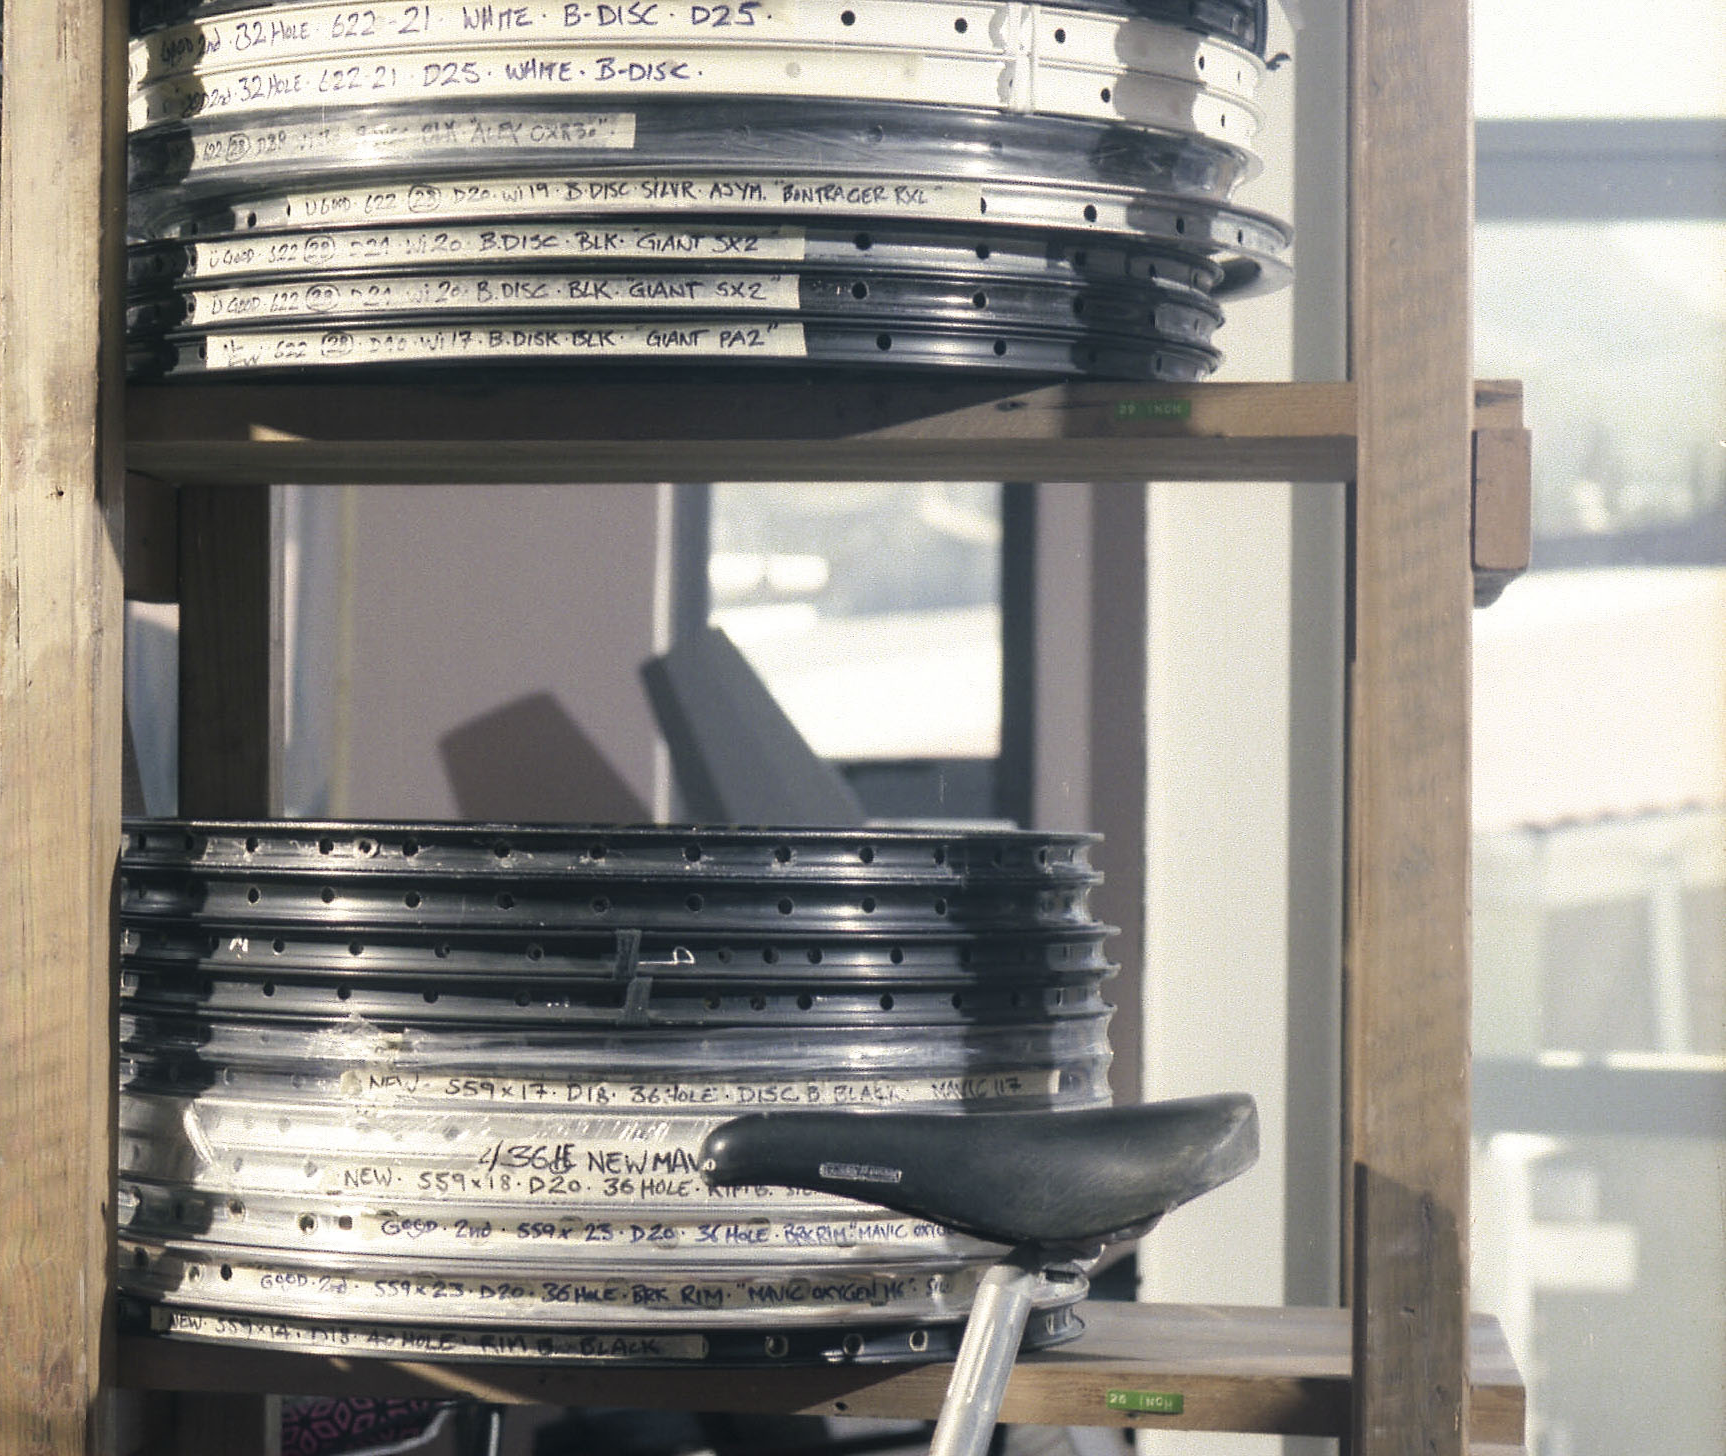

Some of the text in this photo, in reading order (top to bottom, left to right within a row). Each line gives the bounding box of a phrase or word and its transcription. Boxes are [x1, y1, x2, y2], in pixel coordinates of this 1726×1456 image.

[463, 1, 762, 31] WHITE B-DISC D25
[422, 58, 690, 86] D25 WHITE B-DISC
[580, 235, 618, 249] BLK
[569, 282, 611, 298] BLK
[572, 330, 615, 347] BLK
[738, 1086, 800, 1103] DISC
[588, 1150, 647, 1175] NEW
[344, 1169, 392, 1187] NEW
[529, 1176, 583, 1194] D20
[641, 1180, 690, 1199] HOLE
[724, 1225, 769, 1243] HOLE
[681, 1286, 724, 1306] RIM
[403, 1334, 455, 1349] HOLE
[580, 1337, 660, 1355] BLACK
